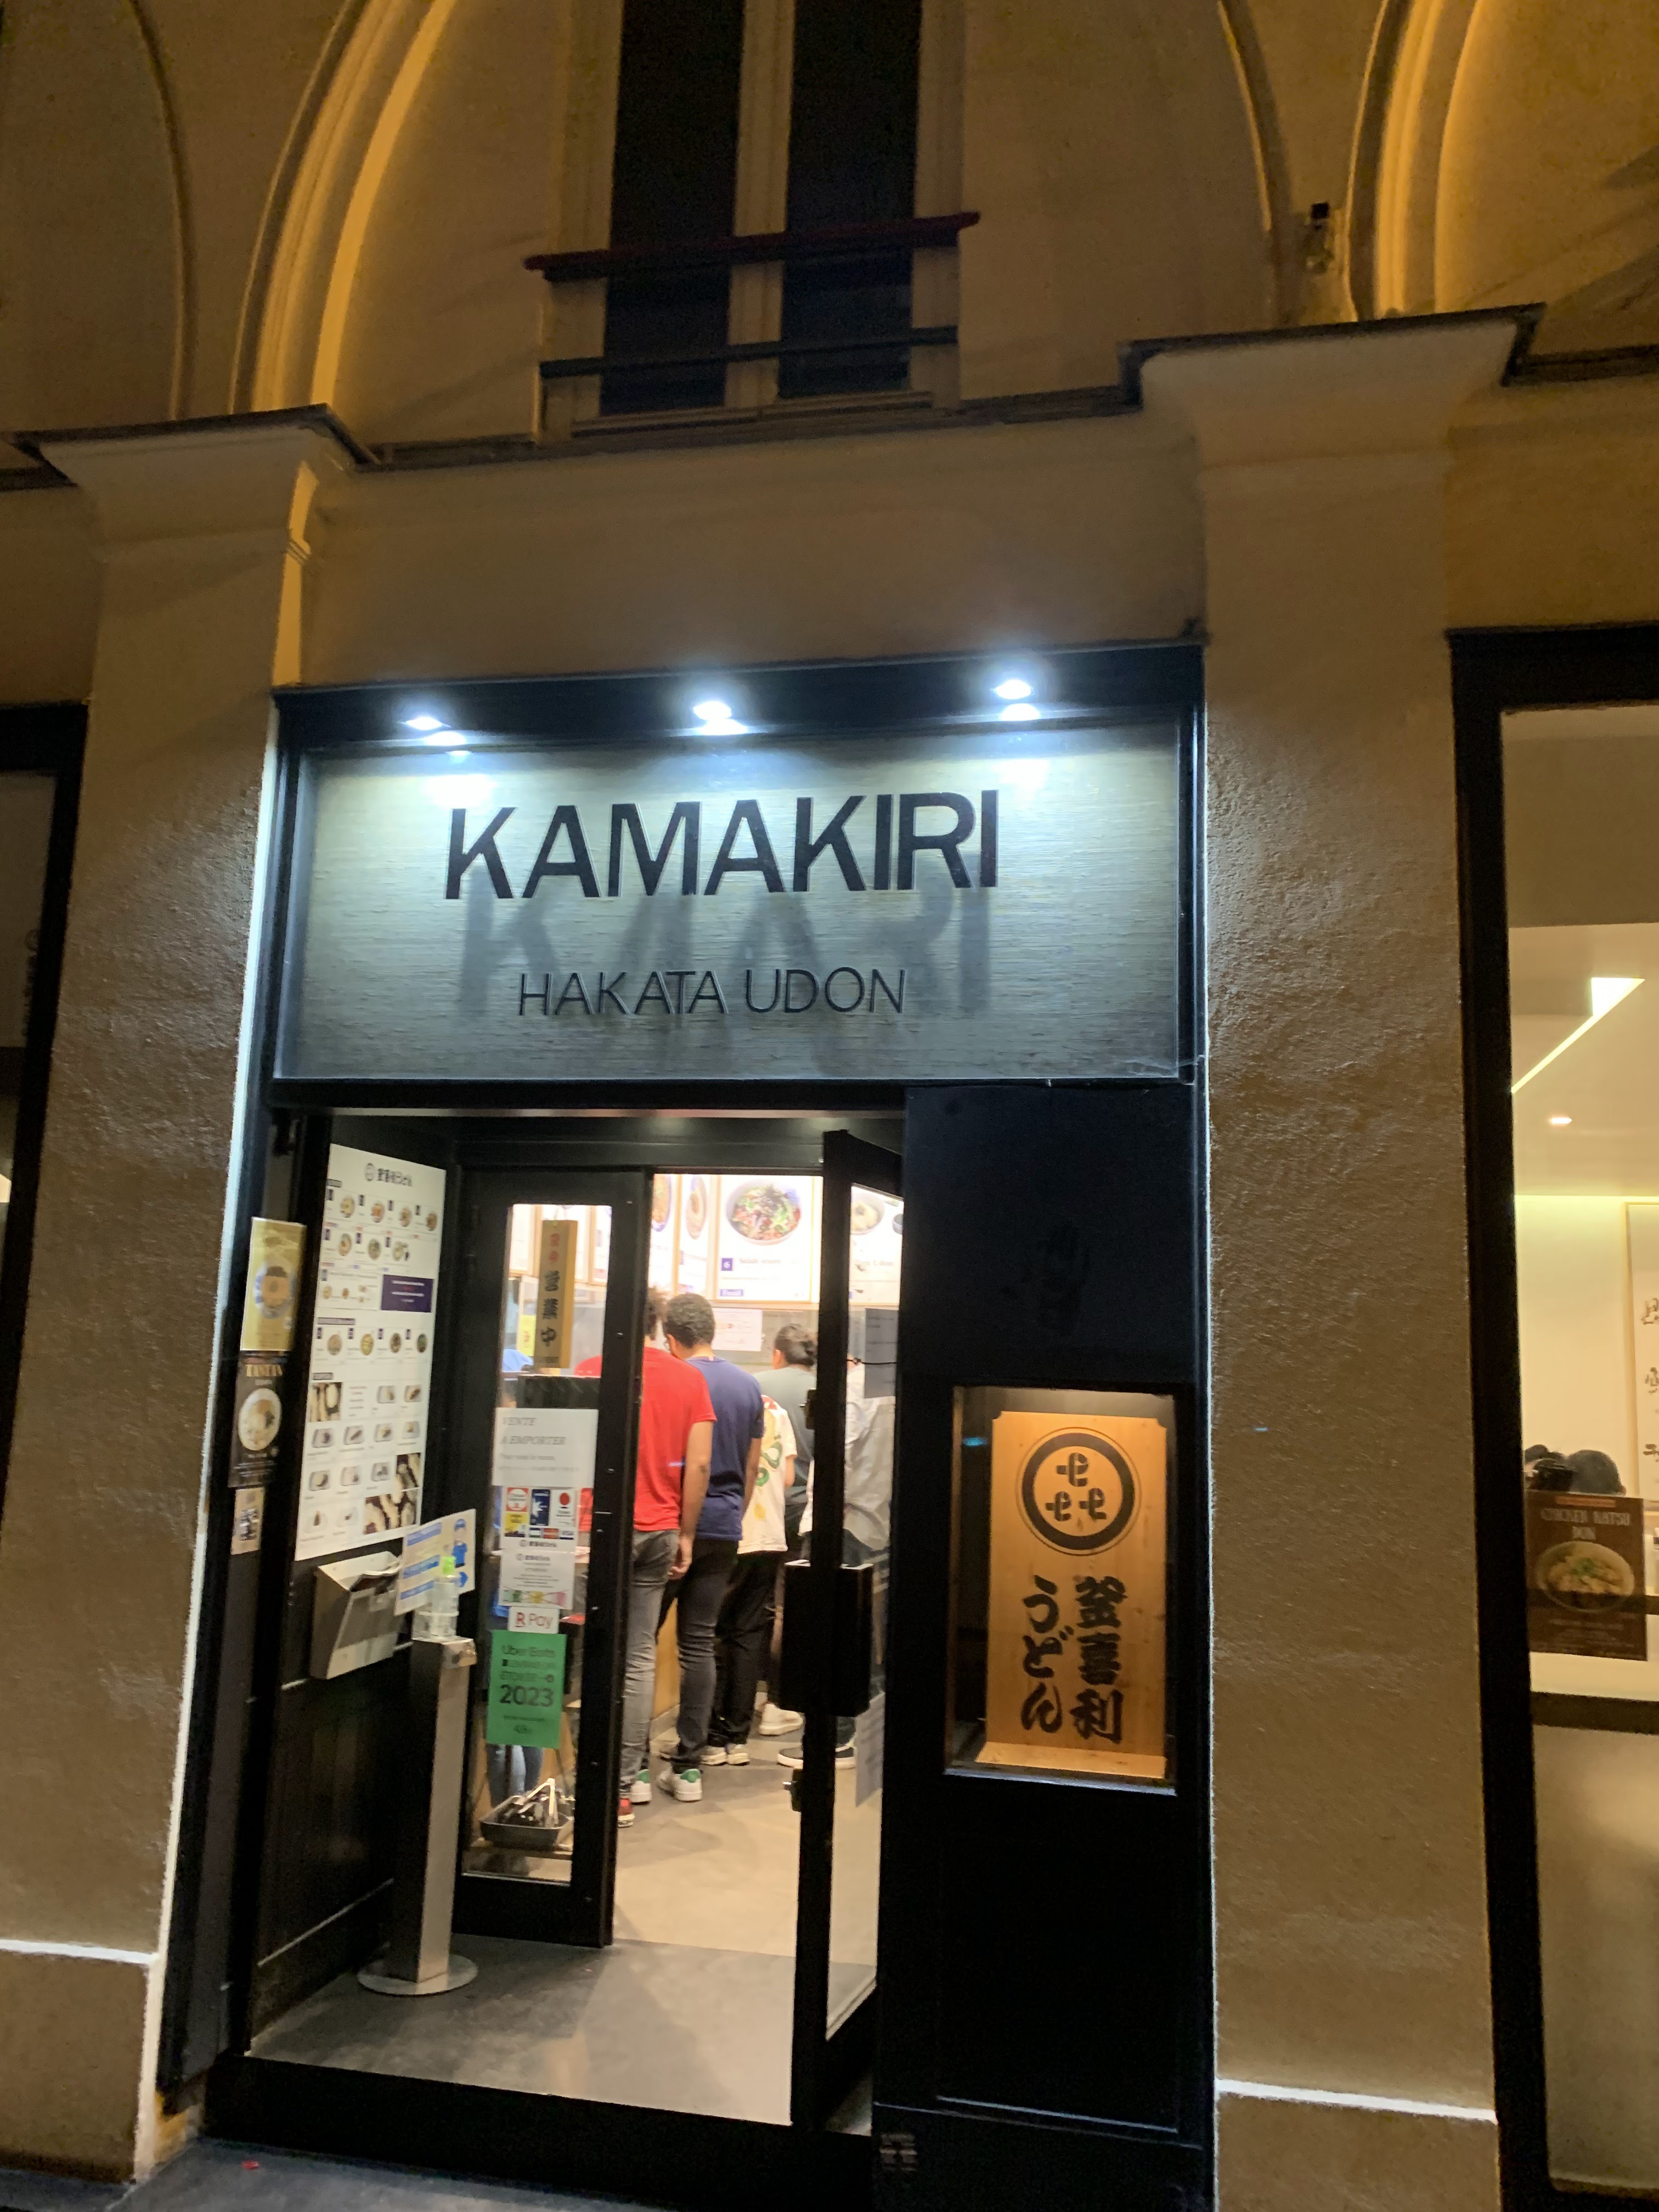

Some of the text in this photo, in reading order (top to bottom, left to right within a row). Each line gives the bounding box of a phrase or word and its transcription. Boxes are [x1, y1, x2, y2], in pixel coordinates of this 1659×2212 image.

[445, 789, 998, 900] KAMAKIRI
[517, 966, 907, 1016] HAKATA UDON
[529, 1613, 554, 1629] Pay
[1020, 1574, 1074, 1734] うどん
[1070, 1575, 1128, 1744] 釜喜利
[499, 1684, 555, 1708] 2023
